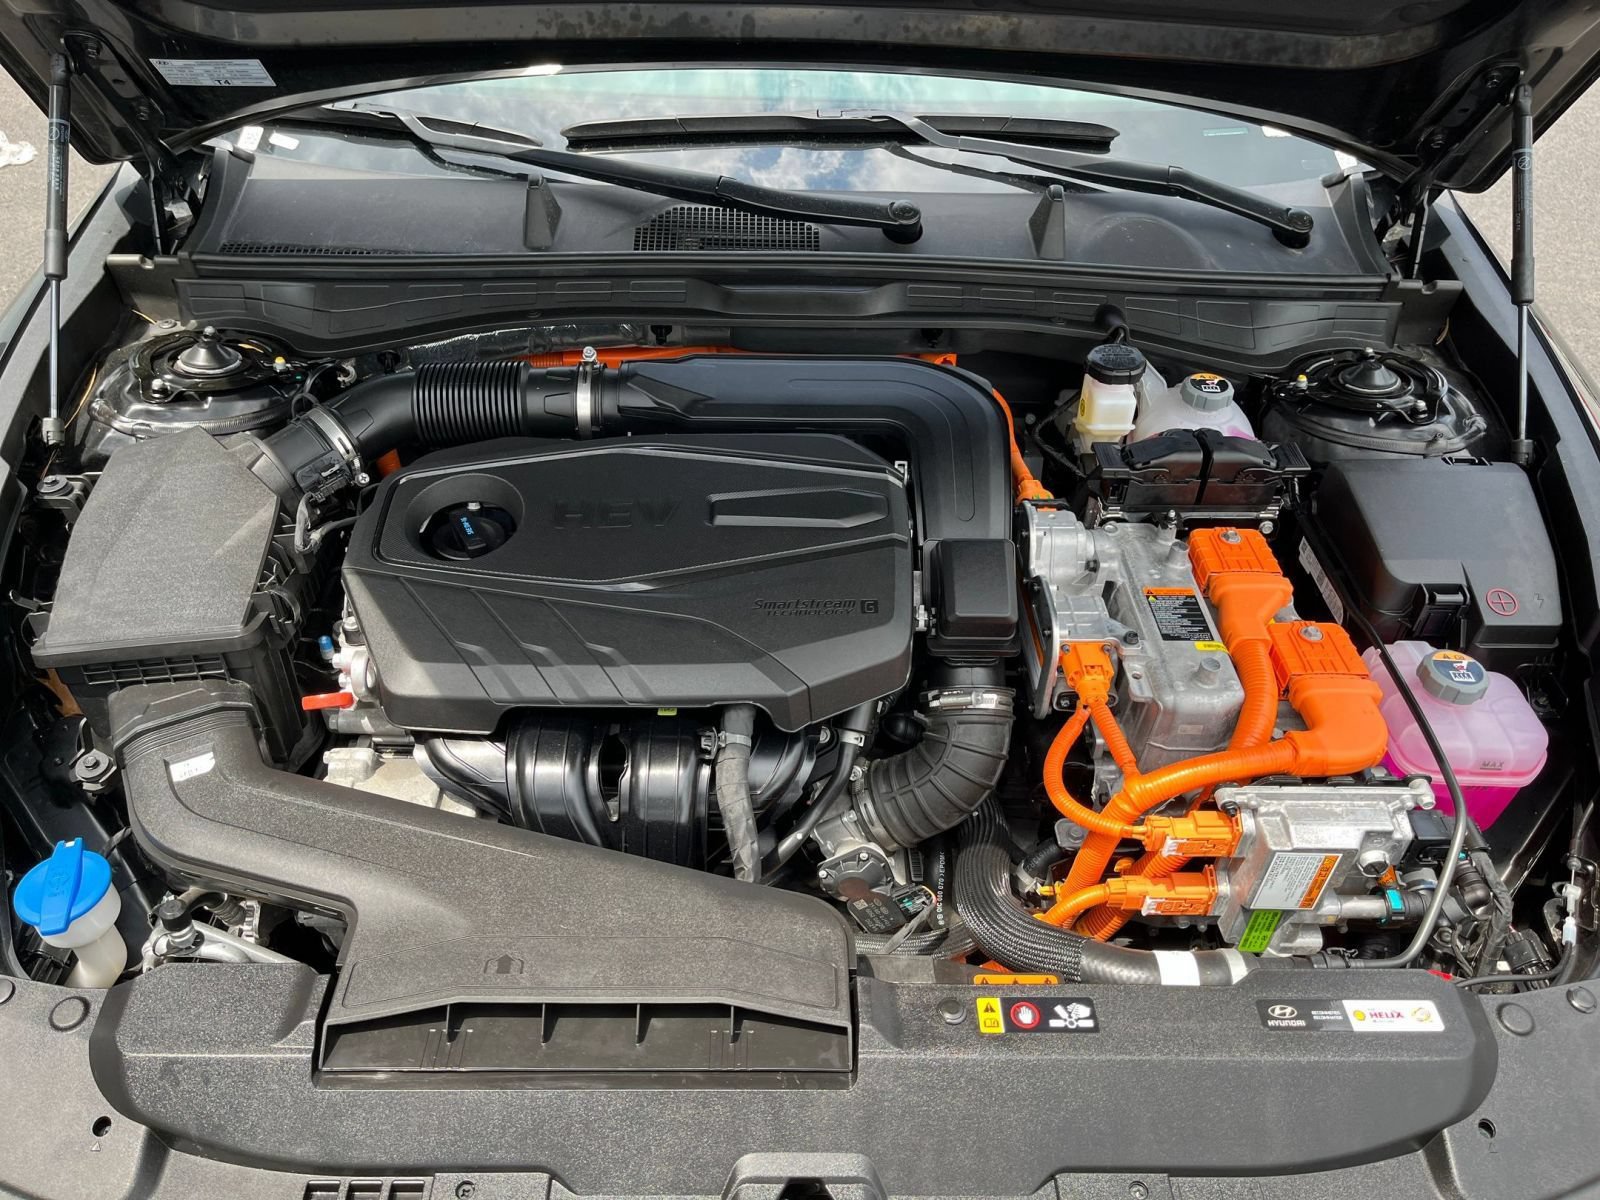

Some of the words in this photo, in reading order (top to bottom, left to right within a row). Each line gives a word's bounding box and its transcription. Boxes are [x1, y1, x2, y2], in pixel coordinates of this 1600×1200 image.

[553, 497, 683, 529] HEV
[752, 598, 857, 611] Smartstream
[861, 599, 878, 614] G
[767, 608, 855, 617] TECHNOLOGY
[1369, 1010, 1404, 1019] HELIX
[1267, 1019, 1307, 1027] HYUNDAI
